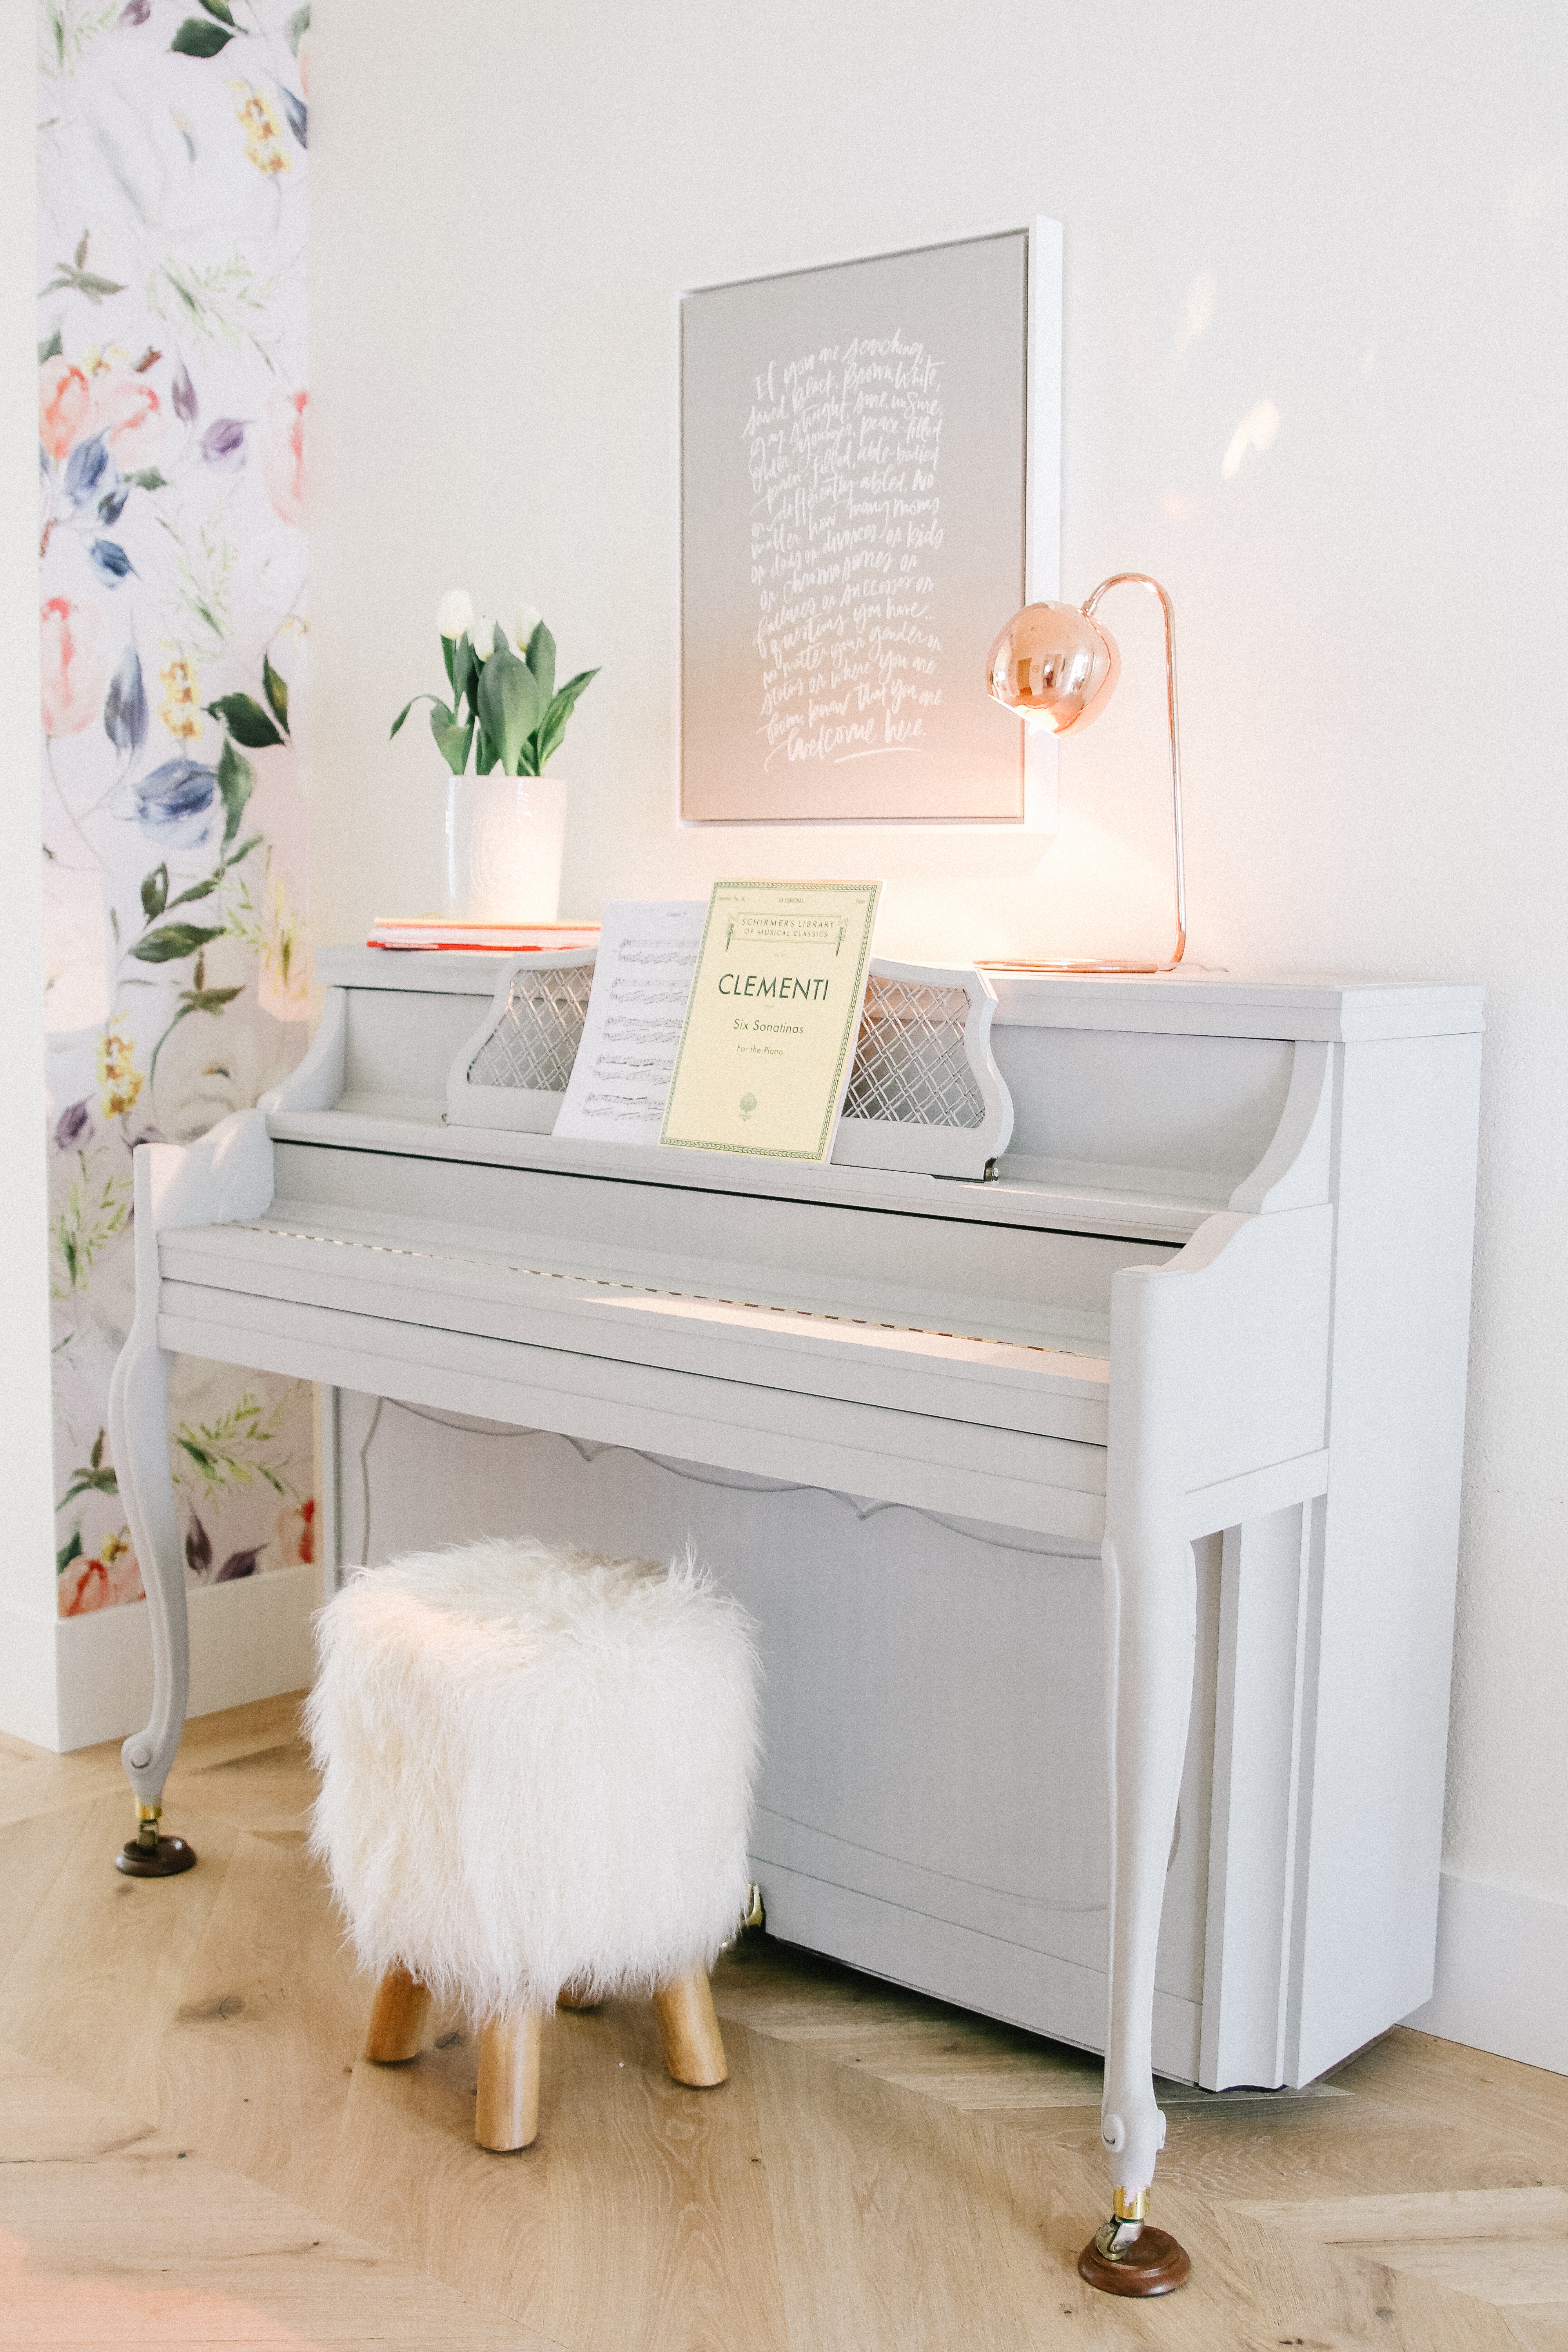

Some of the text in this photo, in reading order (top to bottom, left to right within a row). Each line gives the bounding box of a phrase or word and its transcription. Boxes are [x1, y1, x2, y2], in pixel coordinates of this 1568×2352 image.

[751, 360, 776, 401] If
[784, 354, 815, 396] you
[818, 345, 839, 363] are
[751, 522, 803, 560] matter
[809, 510, 837, 541] how
[893, 497, 939, 517] moms
[751, 565, 766, 585] or
[771, 550, 802, 579] dads
[804, 548, 819, 567] or
[886, 527, 902, 549] or
[906, 517, 943, 550] kids
[760, 589, 776, 613] or
[900, 553, 918, 572] or
[822, 595, 837, 613] or
[916, 576, 935, 593] or
[853, 603, 882, 634] you
[783, 641, 828, 678] matter
[830, 637, 866, 670] your
[868, 621, 928, 662] gender
[927, 634, 942, 652] or
[809, 673, 826, 695] or
[831, 658, 872, 689] where
[878, 649, 907, 685] you
[912, 657, 936, 675] are
[808, 691, 852, 728] know
[852, 681, 887, 713] that
[891, 679, 917, 714] you
[919, 689, 942, 707] are
[764, 718, 878, 773] Welcome
[798, 920, 835, 929] LIBRARY
[718, 973, 829, 1001] CLEMENTI
[733, 1018, 804, 1034] Six Sonatinas
[750, 1045, 761, 1054] the
[764, 1046, 784, 1055] Piano
